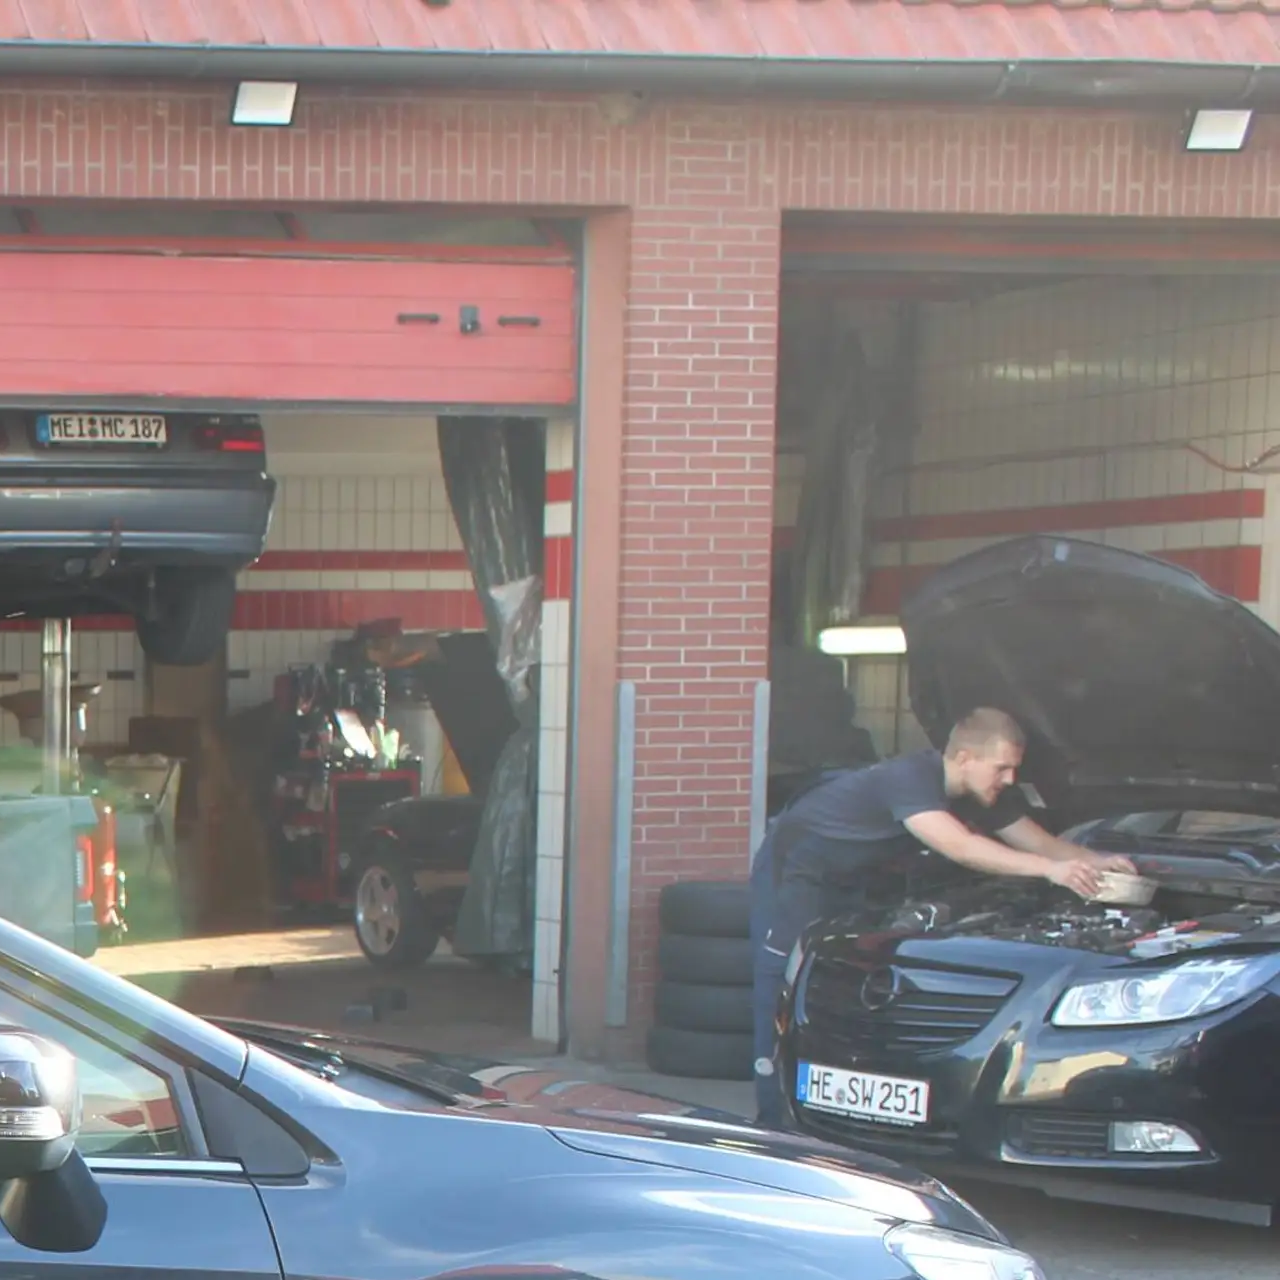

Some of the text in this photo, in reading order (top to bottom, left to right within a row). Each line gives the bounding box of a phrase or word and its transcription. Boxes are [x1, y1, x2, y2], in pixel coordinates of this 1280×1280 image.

[50, 417, 163, 438] MEI MC 187
[809, 1070, 833, 1101] HE
[847, 1077, 875, 1108] SW
[878, 1082, 921, 1116] 251
